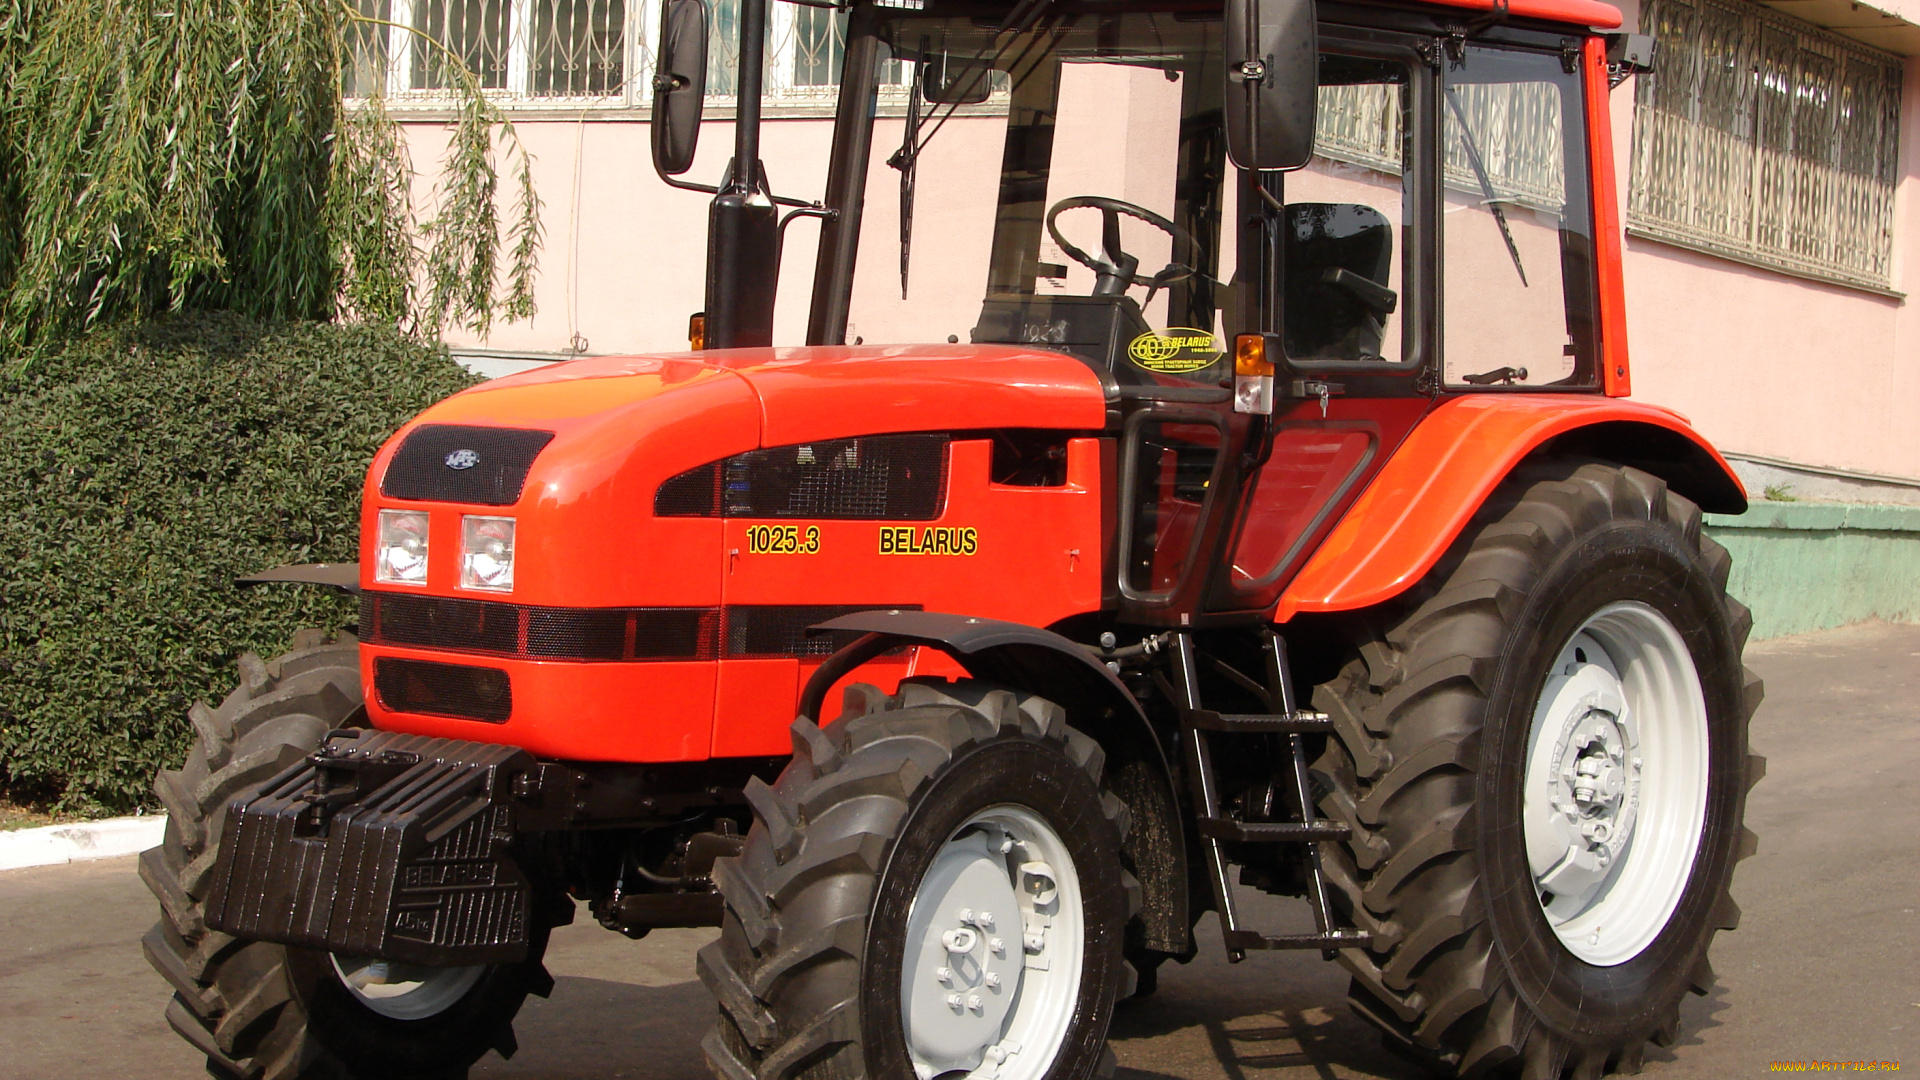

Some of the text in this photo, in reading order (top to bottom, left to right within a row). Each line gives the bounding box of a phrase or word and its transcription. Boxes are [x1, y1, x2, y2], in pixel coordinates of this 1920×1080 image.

[1137, 338, 1159, 357] 60
[747, 525, 978, 556] 1025.3 BELARUS
[406, 863, 491, 886] BELARUS
